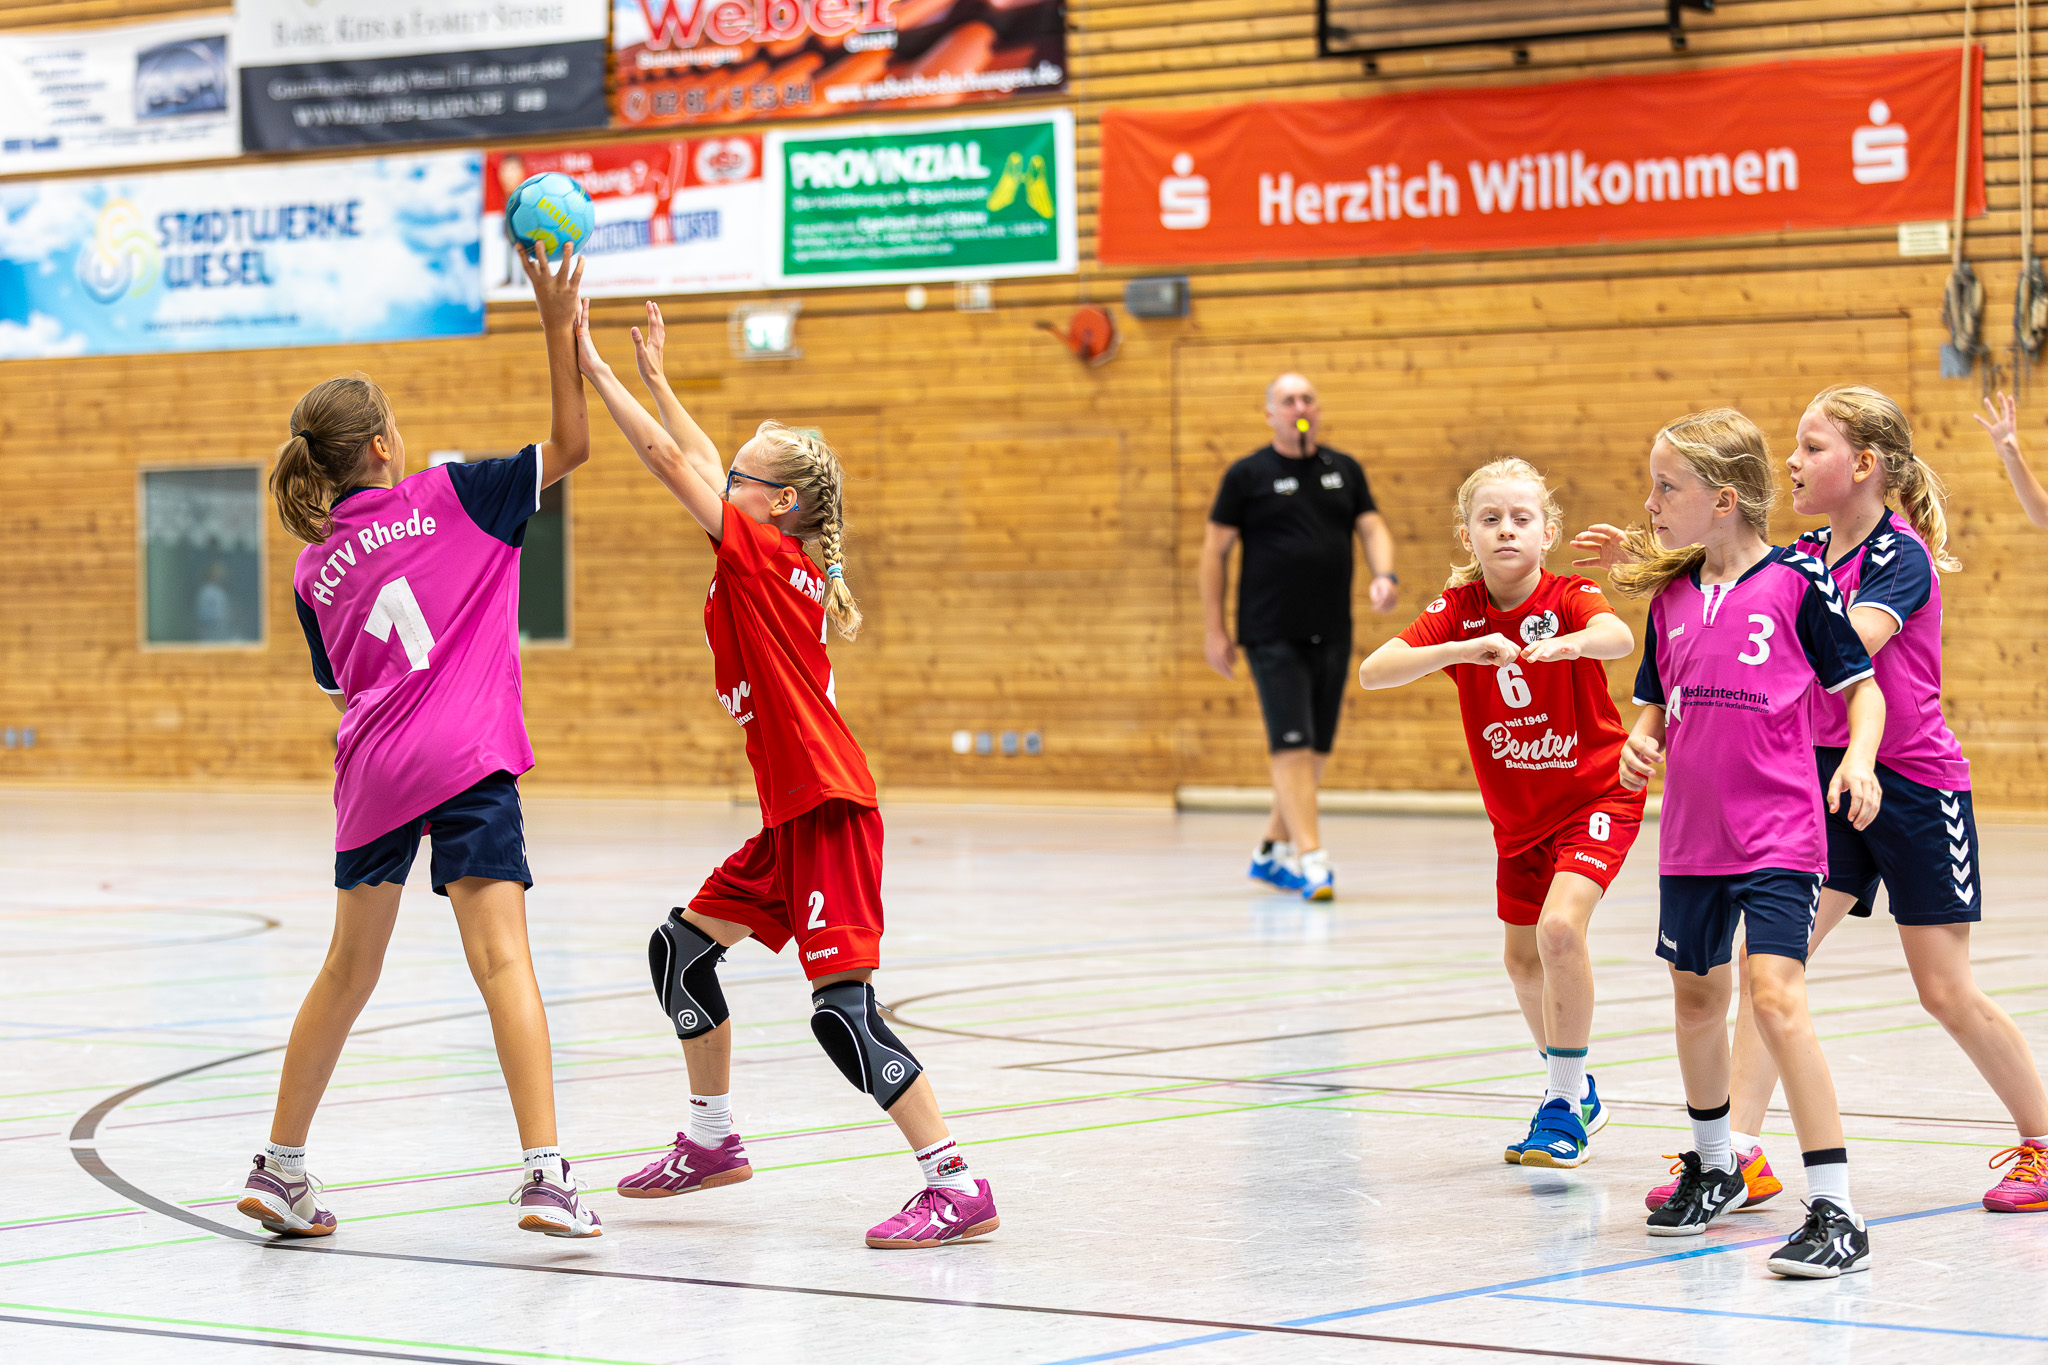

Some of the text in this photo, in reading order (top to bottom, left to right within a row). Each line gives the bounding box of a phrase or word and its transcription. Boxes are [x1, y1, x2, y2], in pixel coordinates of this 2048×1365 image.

[636, 0, 899, 51] Weber
[789, 141, 991, 189] PROVINZIAL
[1258, 147, 1798, 226] Herzlich Willkommen
[157, 200, 362, 248] STADTWERKE
[163, 250, 274, 290] WESEL
[313, 508, 437, 606] HCTV Rhede
[363, 575, 436, 673] 1
[1737, 613, 1775, 666] 3
[1496, 662, 1532, 709] 6
[1680, 685, 1769, 705] Medizintechnik
[1523, 713, 1548, 726] 1948
[1588, 812, 1611, 842] 6
[1574, 851, 1608, 871] Kempa
[807, 890, 827, 931] 2
[806, 946, 838, 962] Kempa
